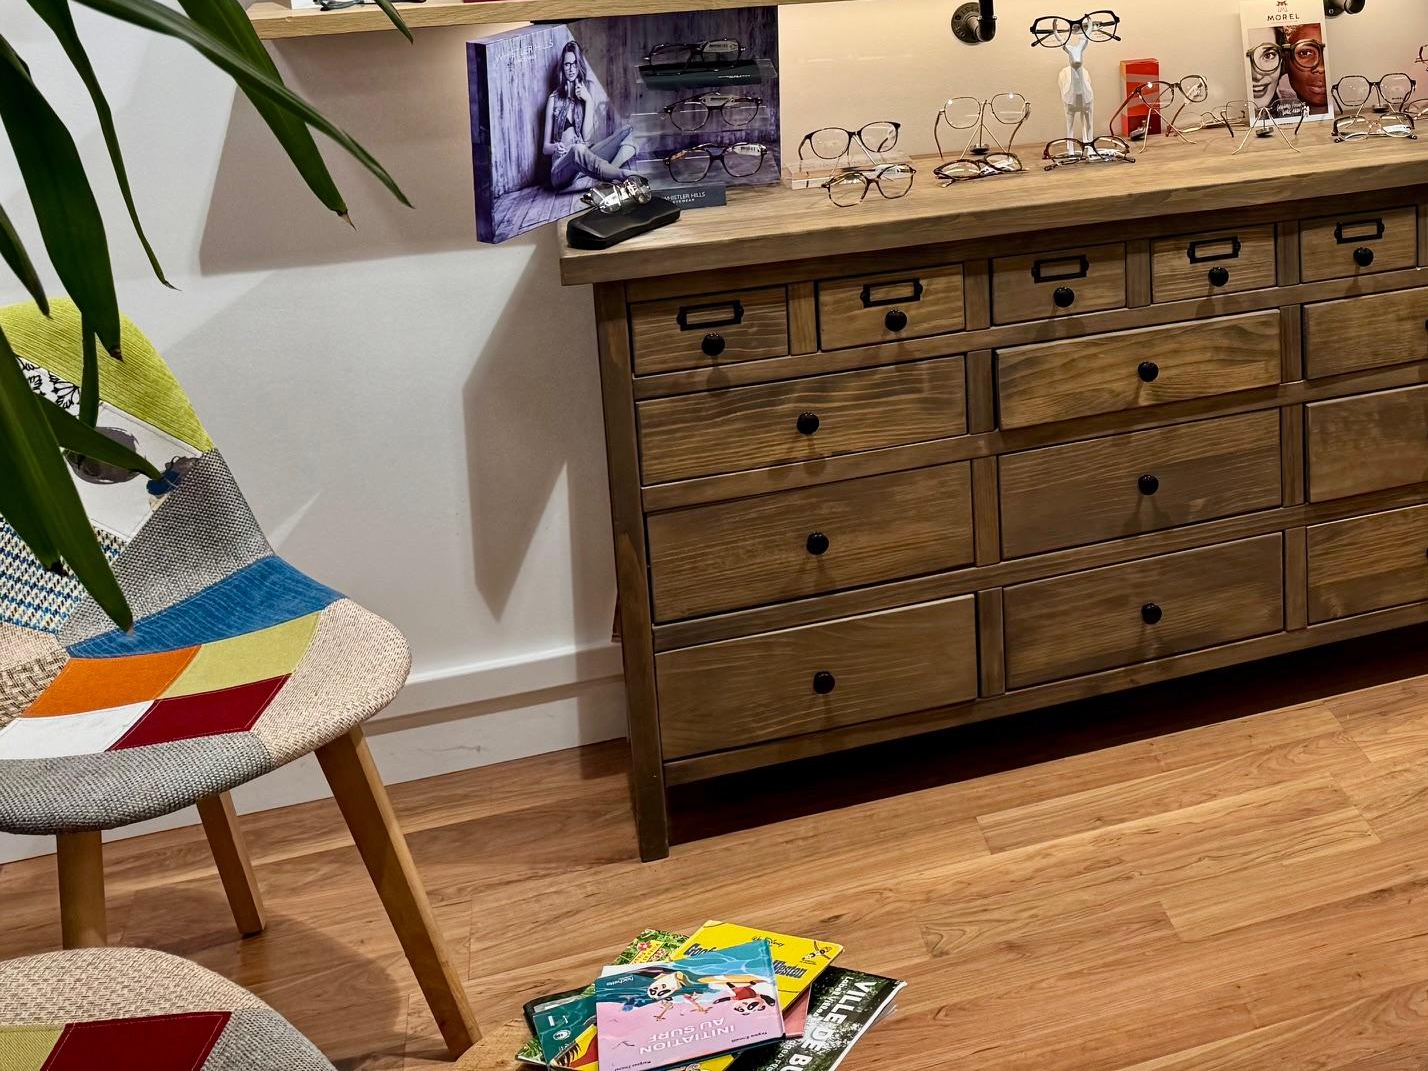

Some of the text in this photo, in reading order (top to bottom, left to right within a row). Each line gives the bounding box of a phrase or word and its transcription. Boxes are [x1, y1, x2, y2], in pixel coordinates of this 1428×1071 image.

[1267, 13, 1300, 21] MOREL
[823, 981, 878, 1025] VILLE
[638, 1025, 735, 1055] INITIATION
[649, 1016, 725, 1044] AU SURF
